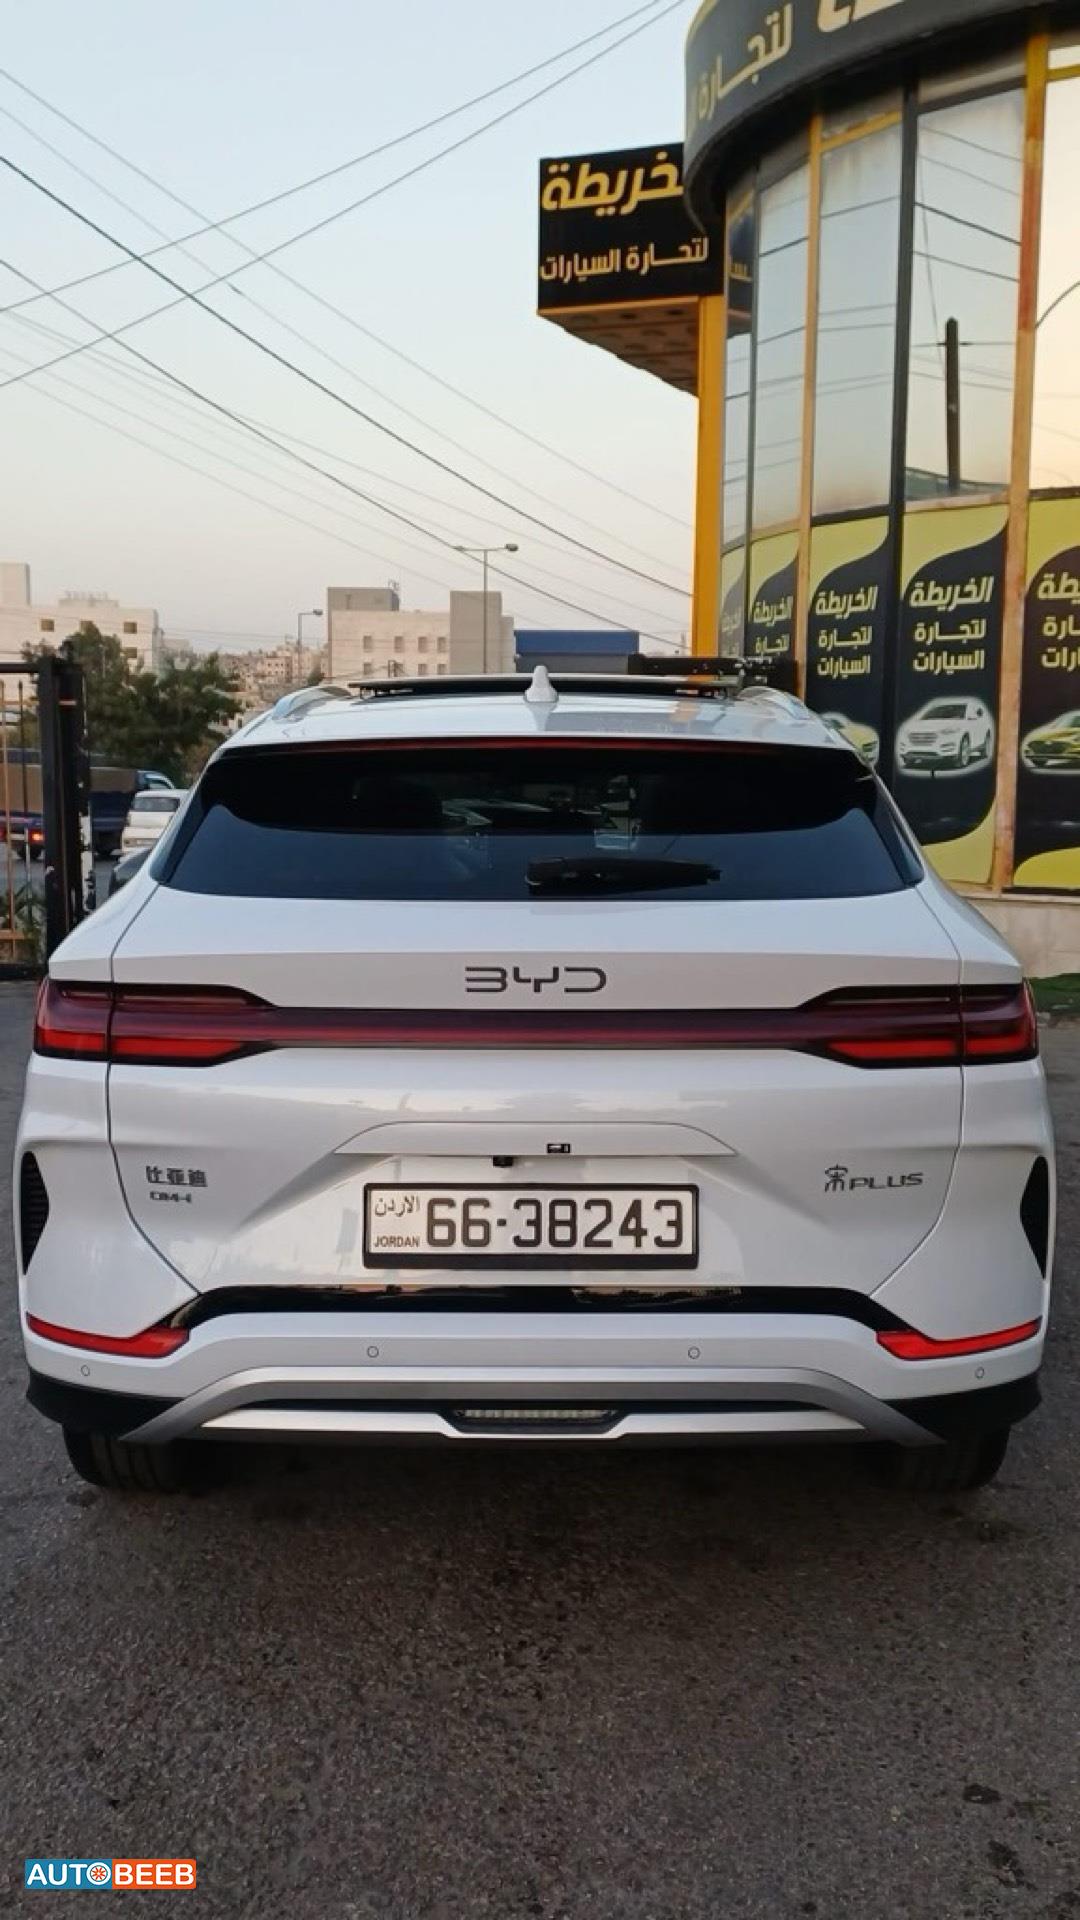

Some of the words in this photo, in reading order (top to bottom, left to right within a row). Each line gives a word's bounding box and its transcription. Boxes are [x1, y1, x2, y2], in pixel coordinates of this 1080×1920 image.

[540, 248, 622, 284] السيارات
[815, 584, 879, 620] الخريطة
[909, 576, 995, 612] الخريطة
[818, 625, 873, 651] لتجارة
[914, 618, 987, 646] لتجارة
[817, 654, 871, 680] السيارات
[912, 649, 985, 676] السيارات
[465, 966, 607, 993] BYD
[145, 1165, 208, 1188] 比亚迪
[849, 1172, 923, 1190] PLUS
[426, 1198, 683, 1248] 66-38243
[373, 1236, 420, 1248] JORDAN
